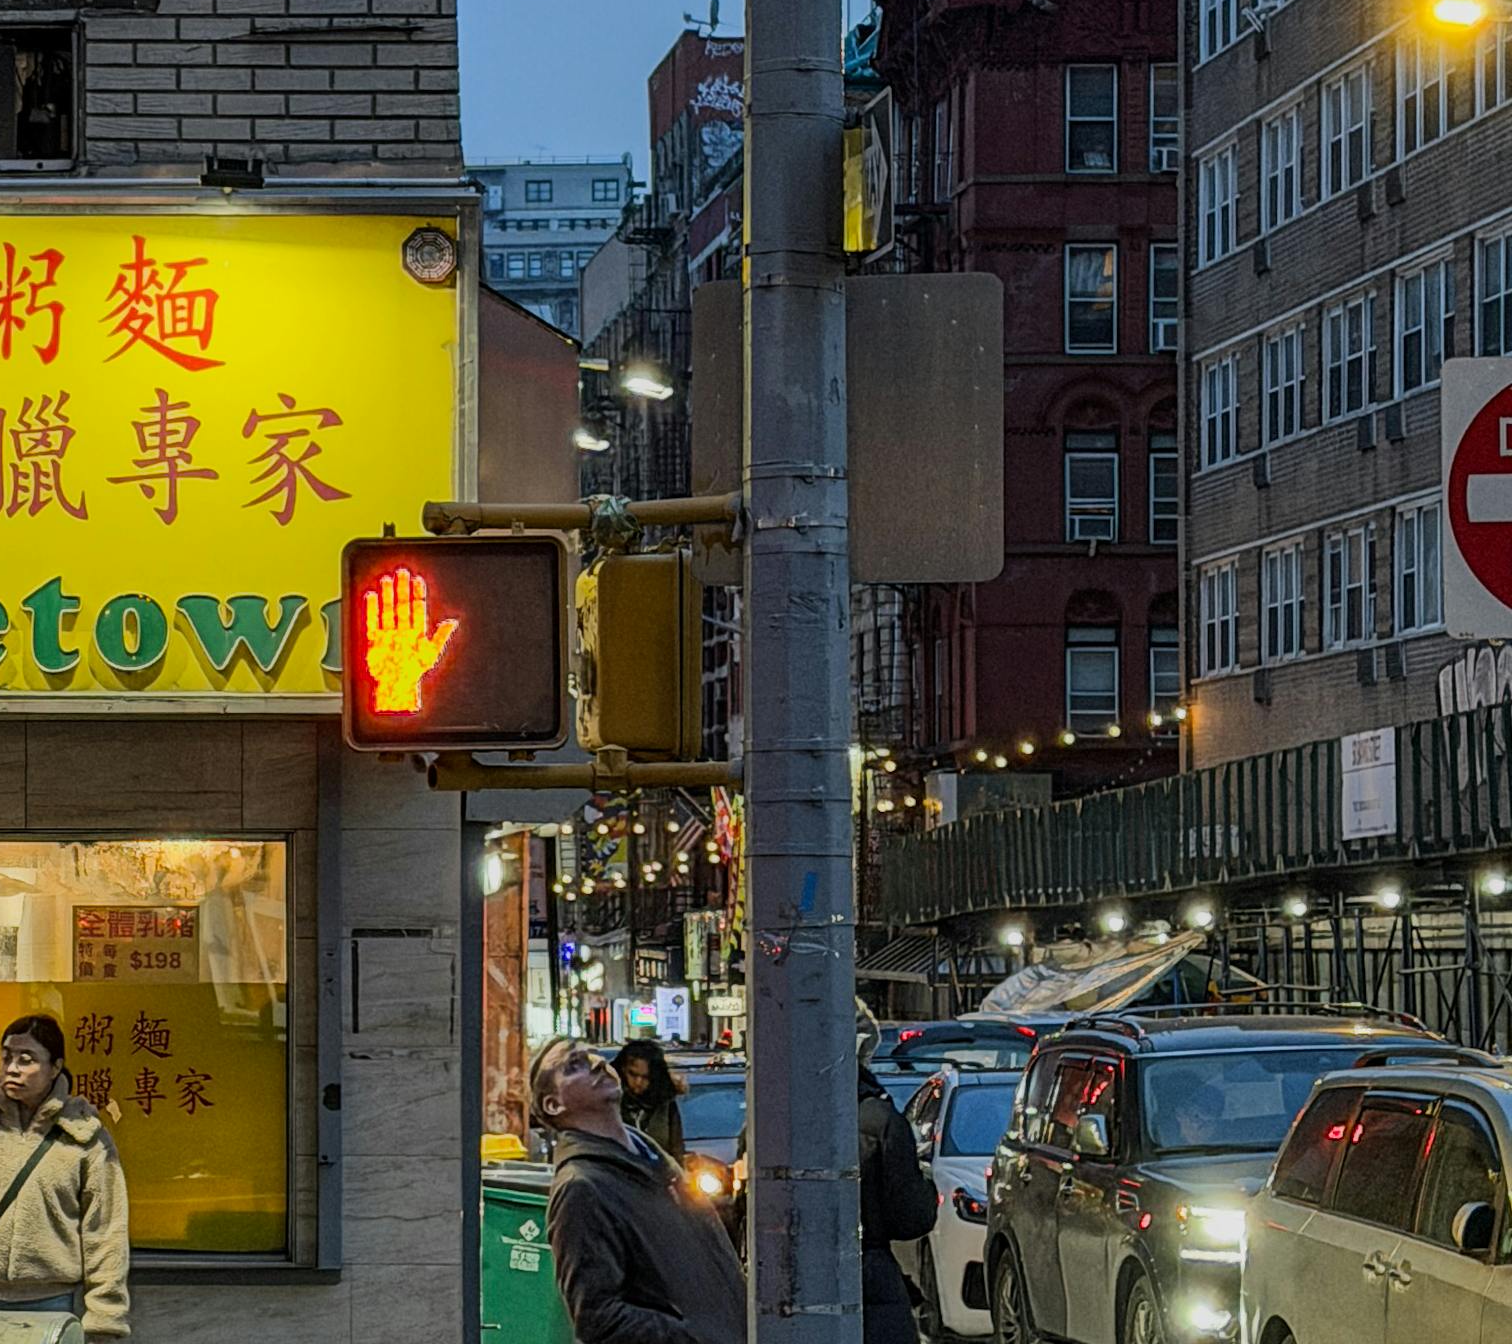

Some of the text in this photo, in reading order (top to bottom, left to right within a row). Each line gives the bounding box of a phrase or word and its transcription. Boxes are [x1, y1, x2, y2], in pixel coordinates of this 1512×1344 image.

[129, 950, 182, 971] $198
[74, 1010, 174, 1059] 粥麵
[76, 1066, 215, 1116] 臘專家
